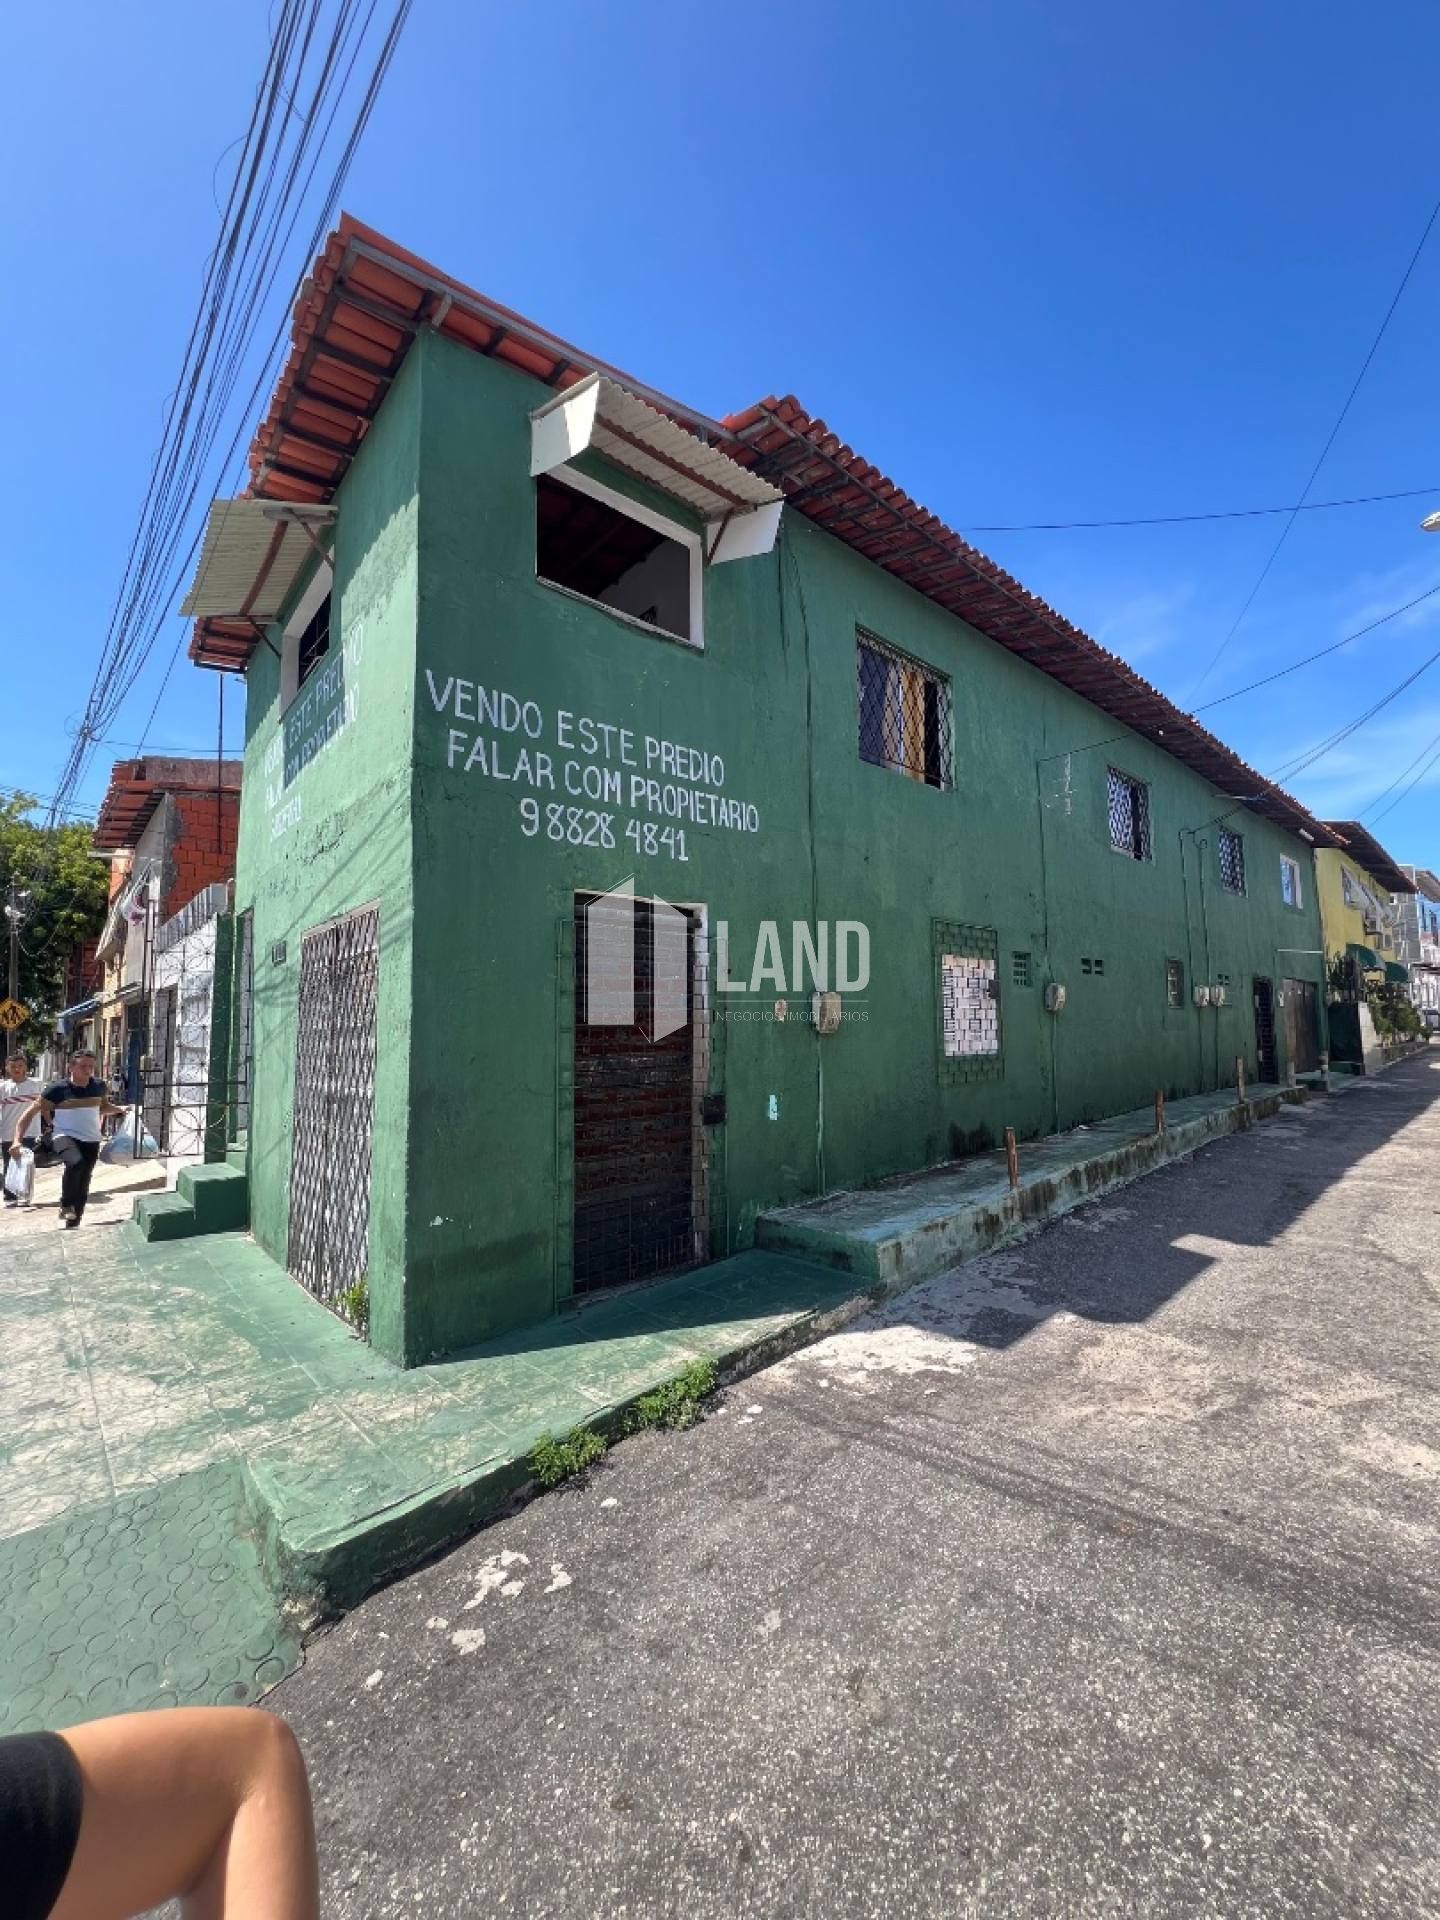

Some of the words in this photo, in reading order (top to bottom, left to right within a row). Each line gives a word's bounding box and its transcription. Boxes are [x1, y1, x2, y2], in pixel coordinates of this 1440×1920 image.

[425, 669, 543, 738] VENDO
[557, 710, 637, 766] ESTE
[645, 735, 724, 786] PREDIO
[448, 729, 555, 790] FALAR
[564, 761, 621, 805] COM
[630, 775, 760, 833] PROPIETARIO
[625, 819, 689, 861] 4841
